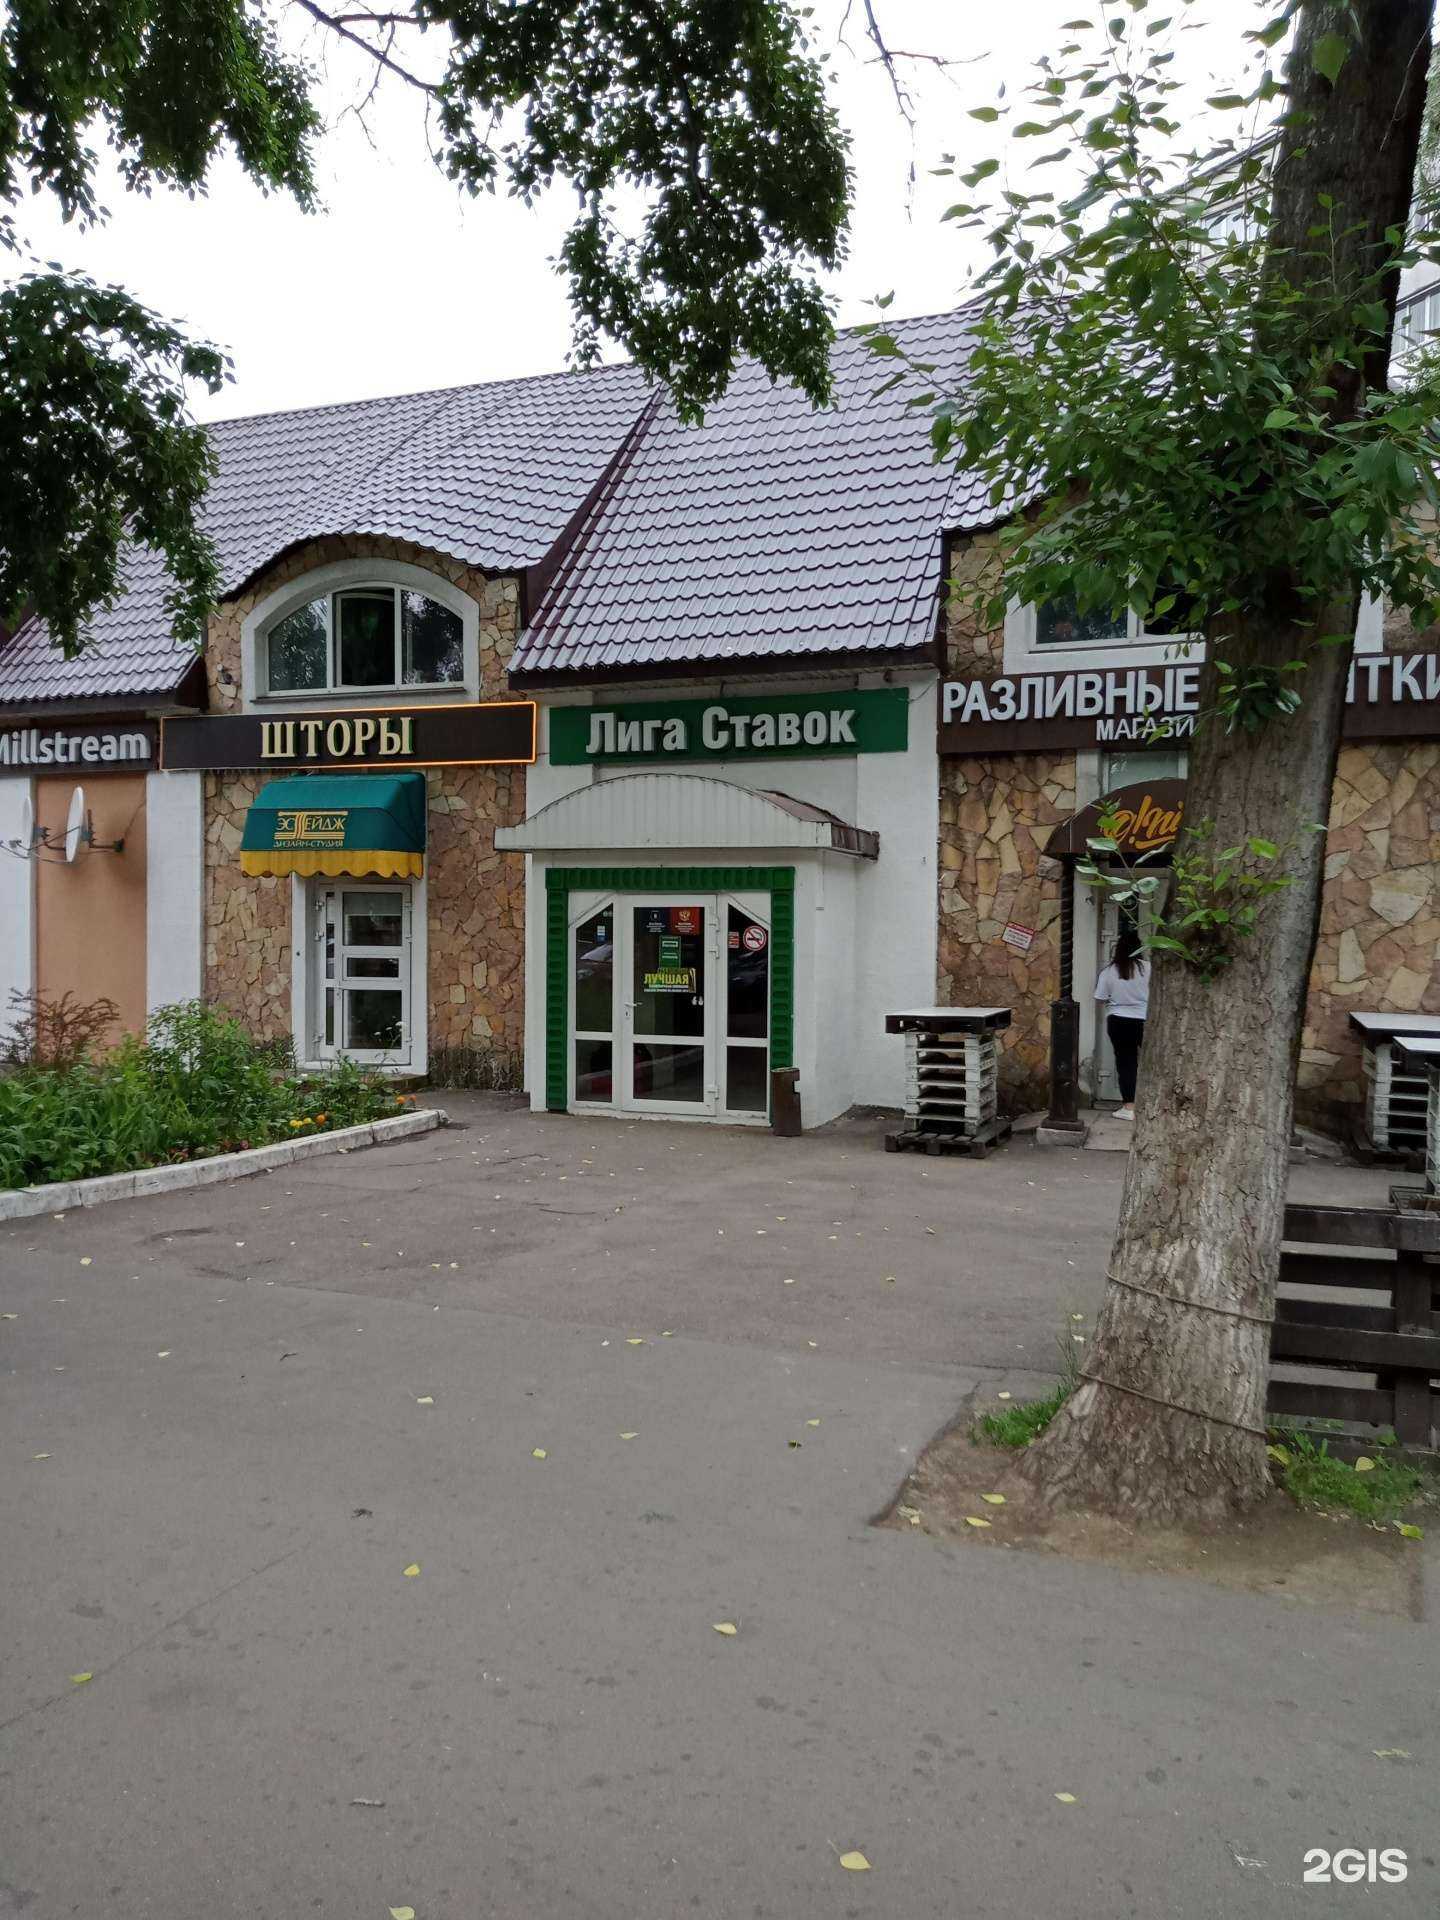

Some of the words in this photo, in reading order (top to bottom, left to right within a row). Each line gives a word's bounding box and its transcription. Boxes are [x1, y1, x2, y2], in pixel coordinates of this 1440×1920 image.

[943, 667, 1200, 724] РАЗЛИВНЫЕ
[260, 716, 414, 758] ШТОРЫ
[586, 712, 687, 753] Лига
[702, 706, 857, 749] Ставок
[1096, 716, 1195, 740] МАГАЗИ
[275, 811, 348, 835] ЭСТЕЙДЖ
[644, 973, 689, 985] ЛУЧШАЯ
